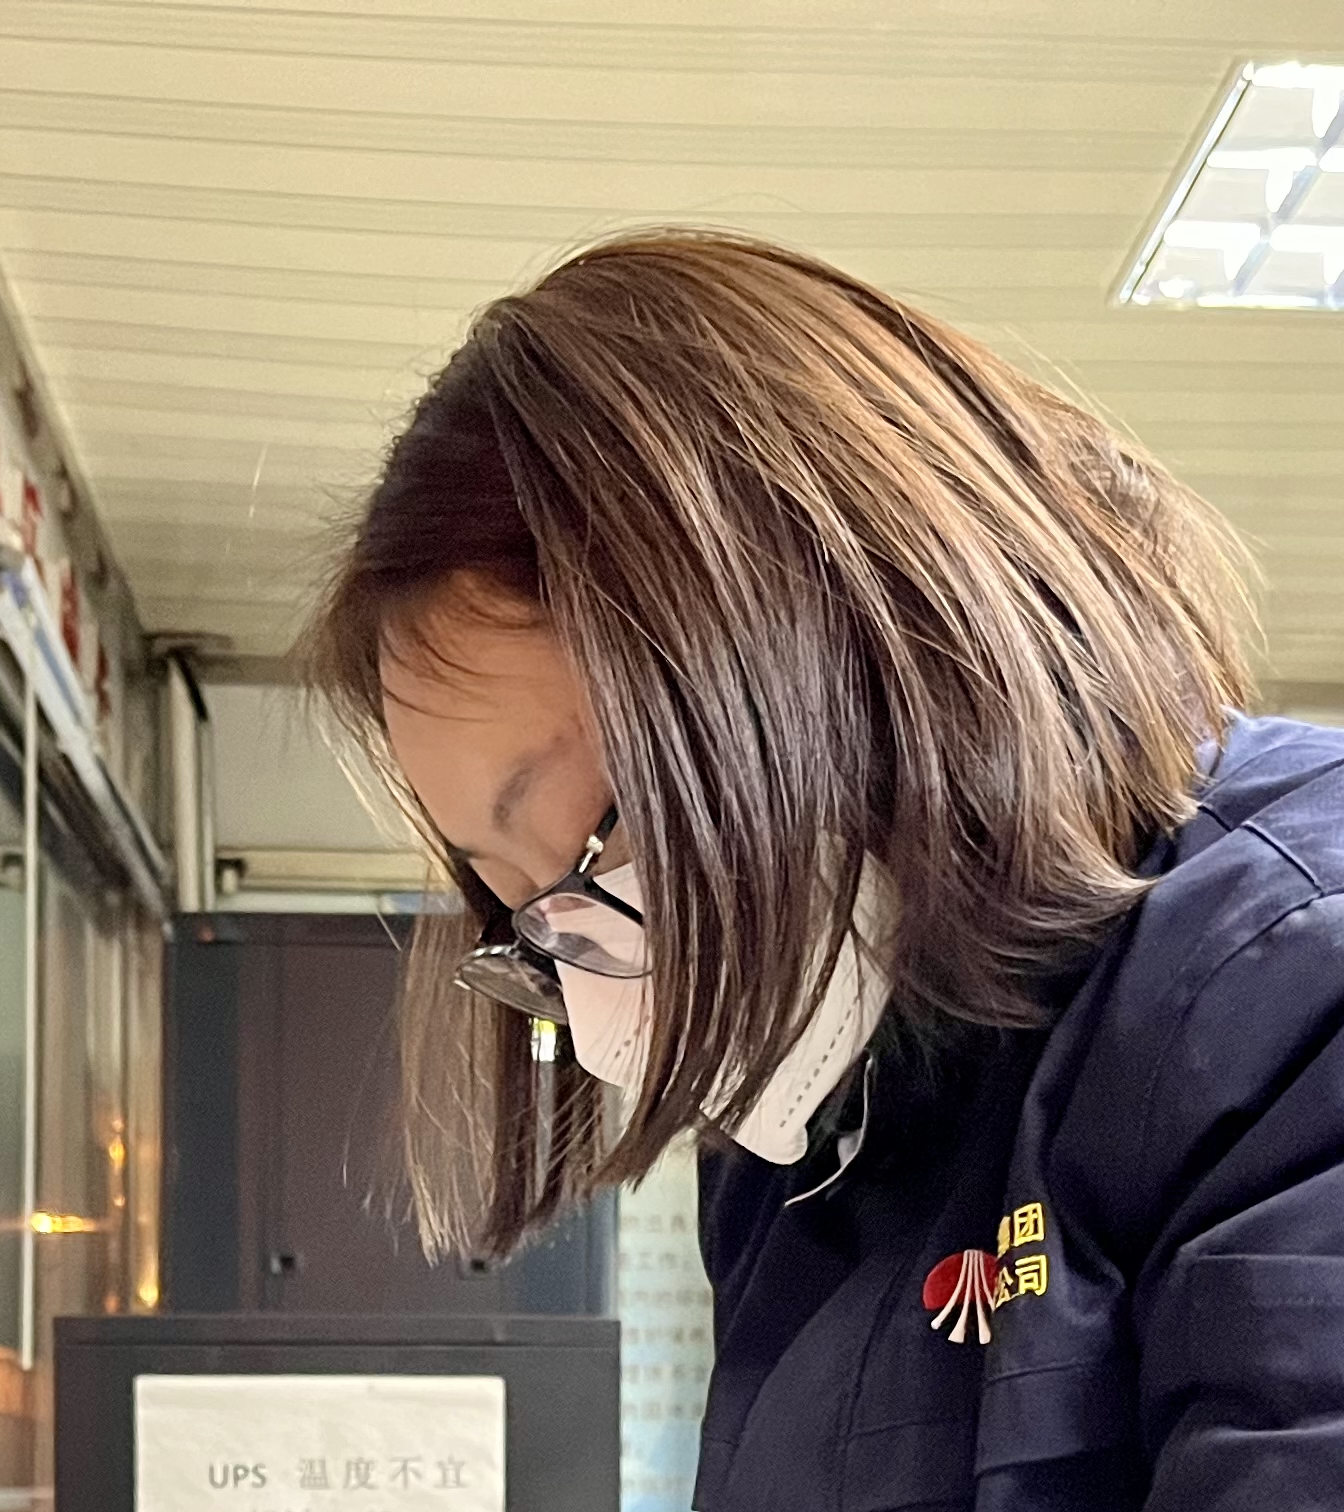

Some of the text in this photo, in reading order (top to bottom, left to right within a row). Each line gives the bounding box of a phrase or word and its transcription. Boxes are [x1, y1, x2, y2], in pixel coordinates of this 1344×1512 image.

[208, 1456, 471, 1491] UPS 温度不宜
